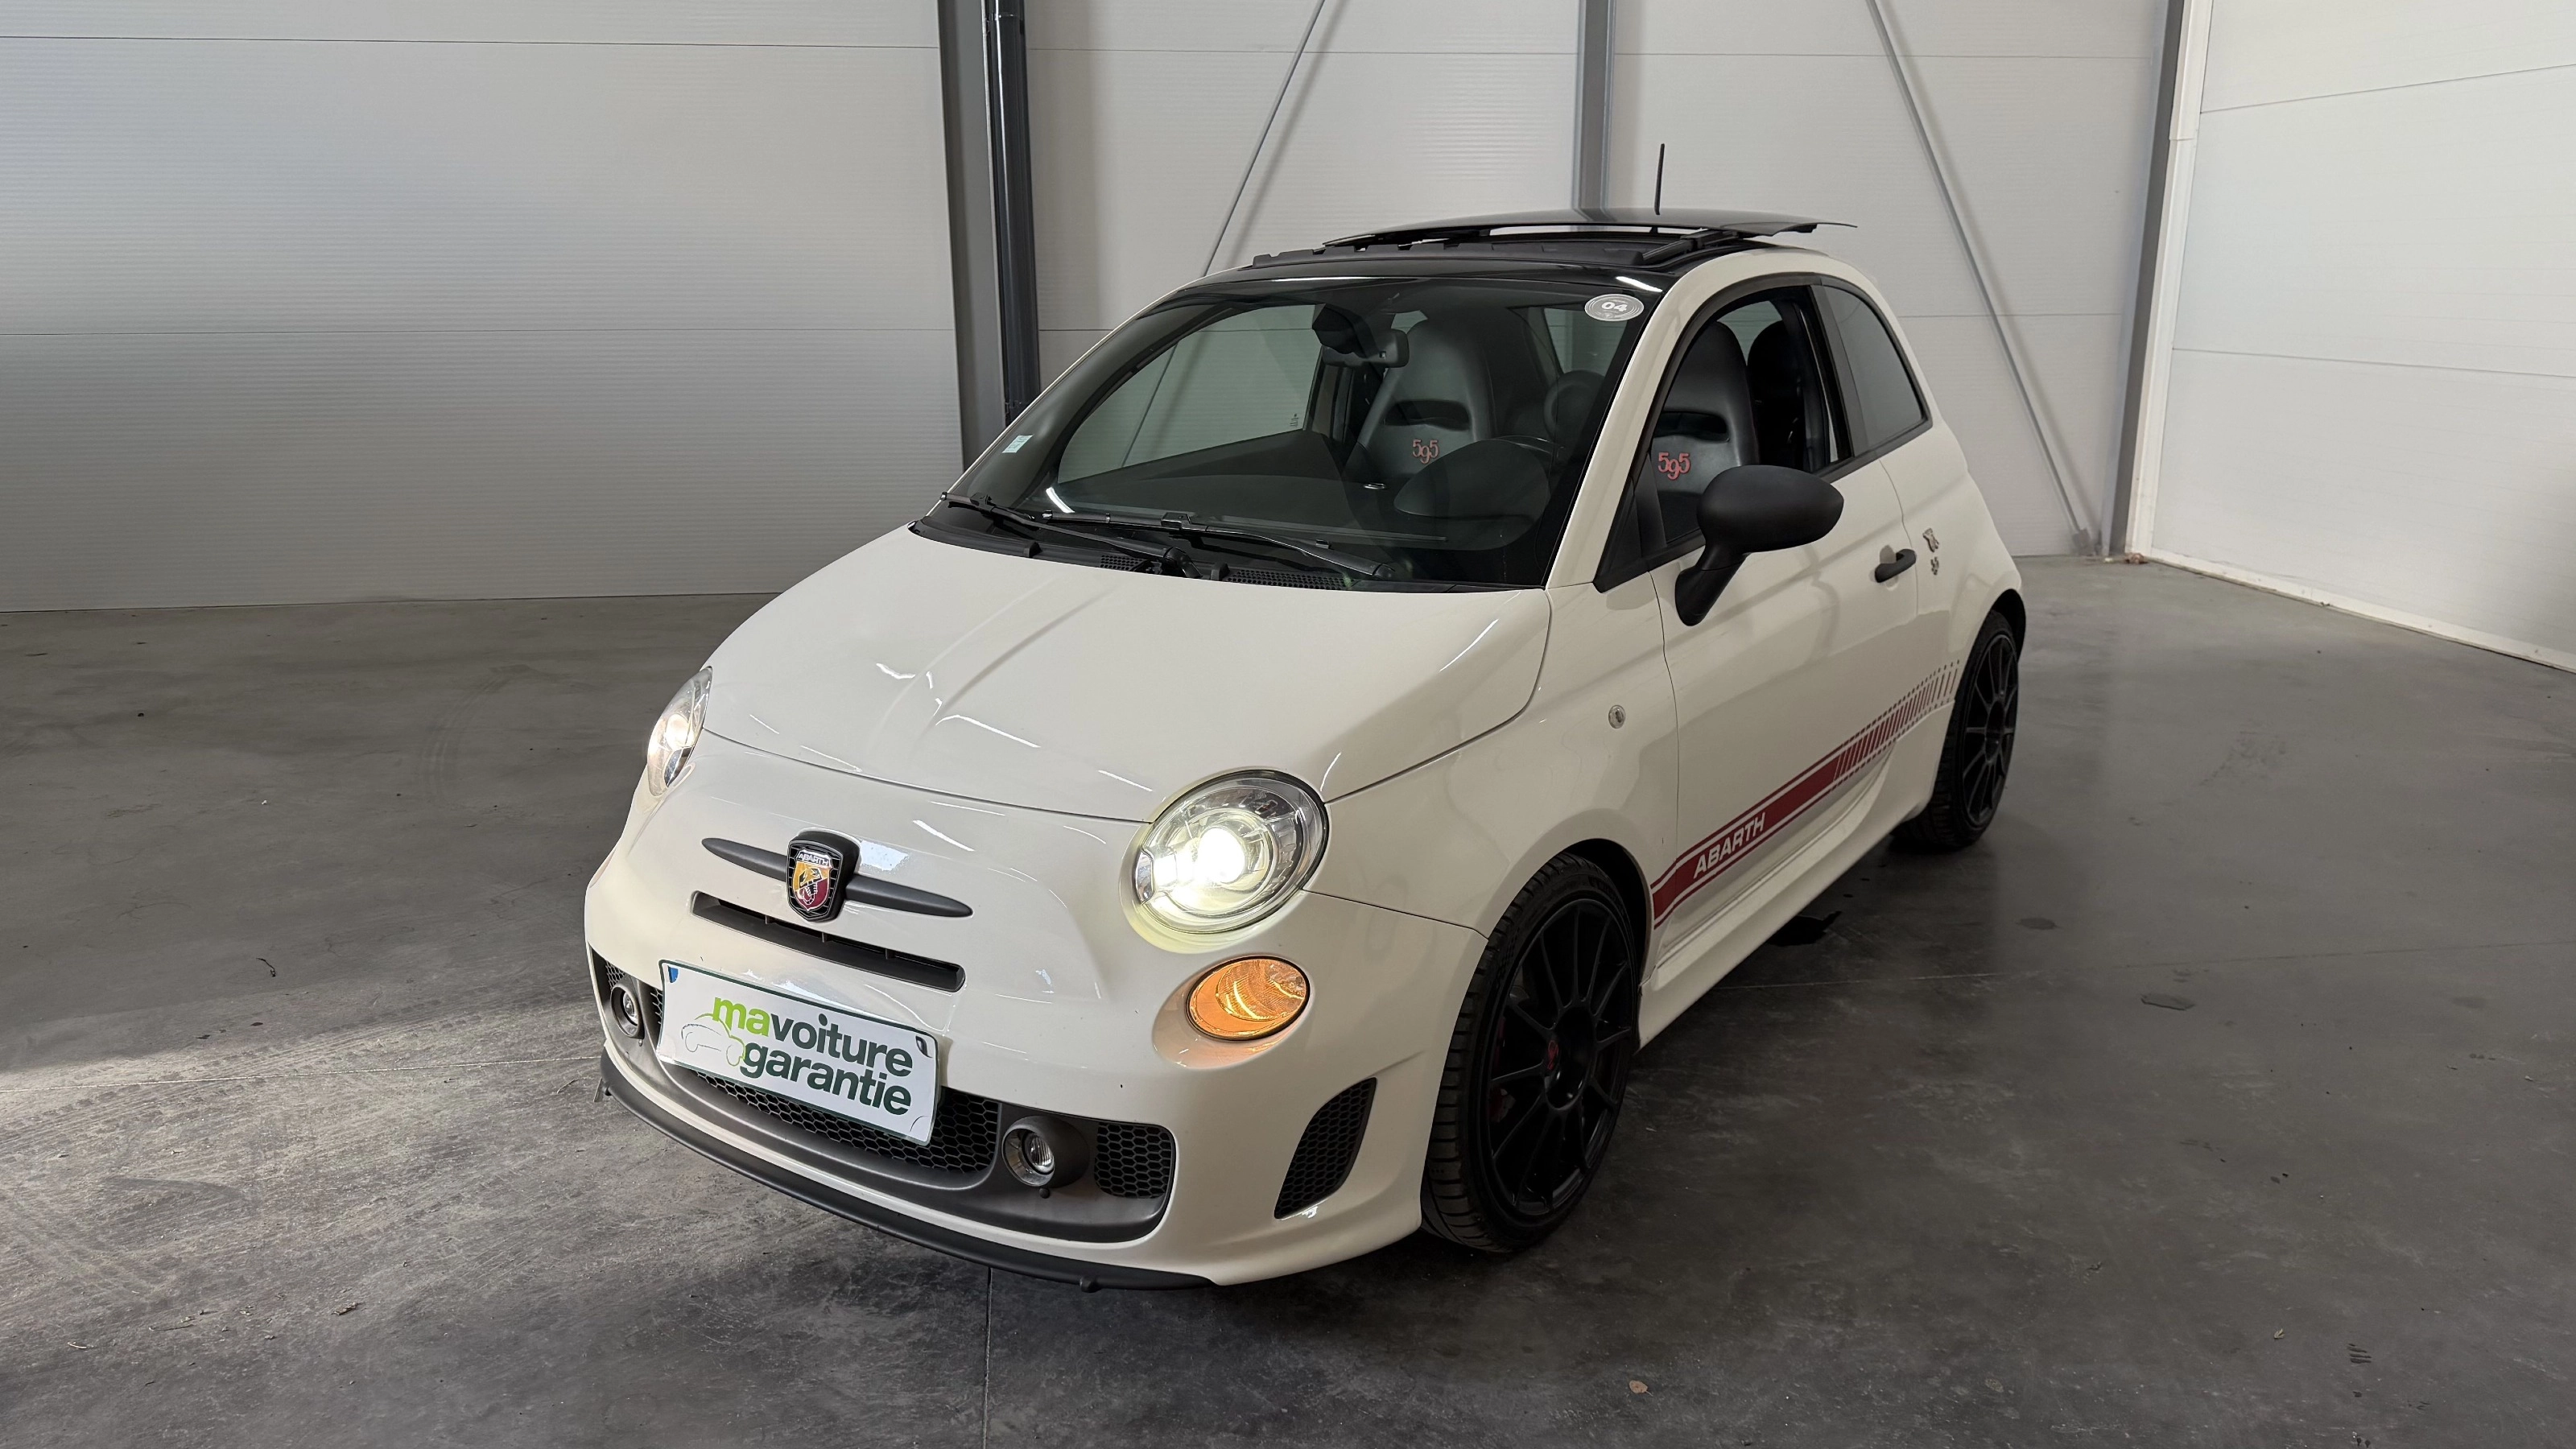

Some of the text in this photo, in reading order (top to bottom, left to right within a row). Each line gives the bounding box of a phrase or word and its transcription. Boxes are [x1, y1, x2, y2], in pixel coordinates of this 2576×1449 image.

[1601, 301, 1628, 312] 04
[1412, 439, 1439, 464] 595
[1657, 452, 1690, 480] 595
[1693, 812, 1765, 879] ABARTH
[798, 853, 830, 866] ABARTH
[740, 1041, 912, 1116] garantie
